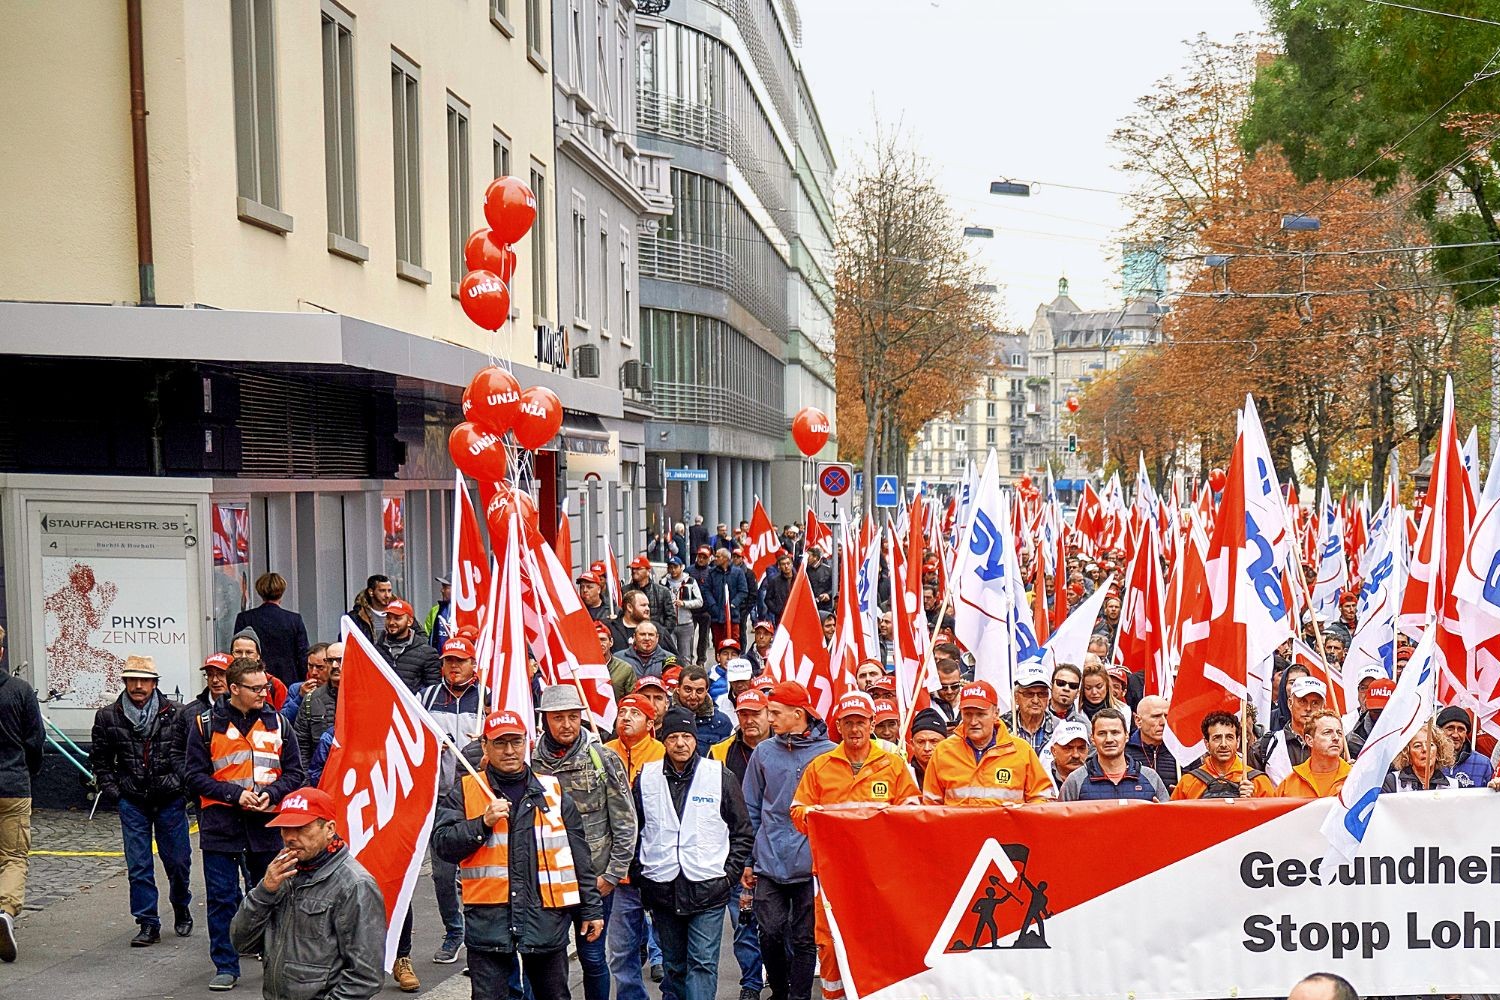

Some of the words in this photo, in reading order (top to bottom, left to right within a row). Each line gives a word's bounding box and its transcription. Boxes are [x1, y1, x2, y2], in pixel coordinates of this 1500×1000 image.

[521, 401, 547, 420] NiA
[49, 519, 159, 530] STAUFFACHERSTR.
[162, 522, 179, 530] 35
[49, 541, 58, 549] 4
[102, 631, 186, 644] ZENTRUM
[1243, 914, 1391, 960] Stopp
